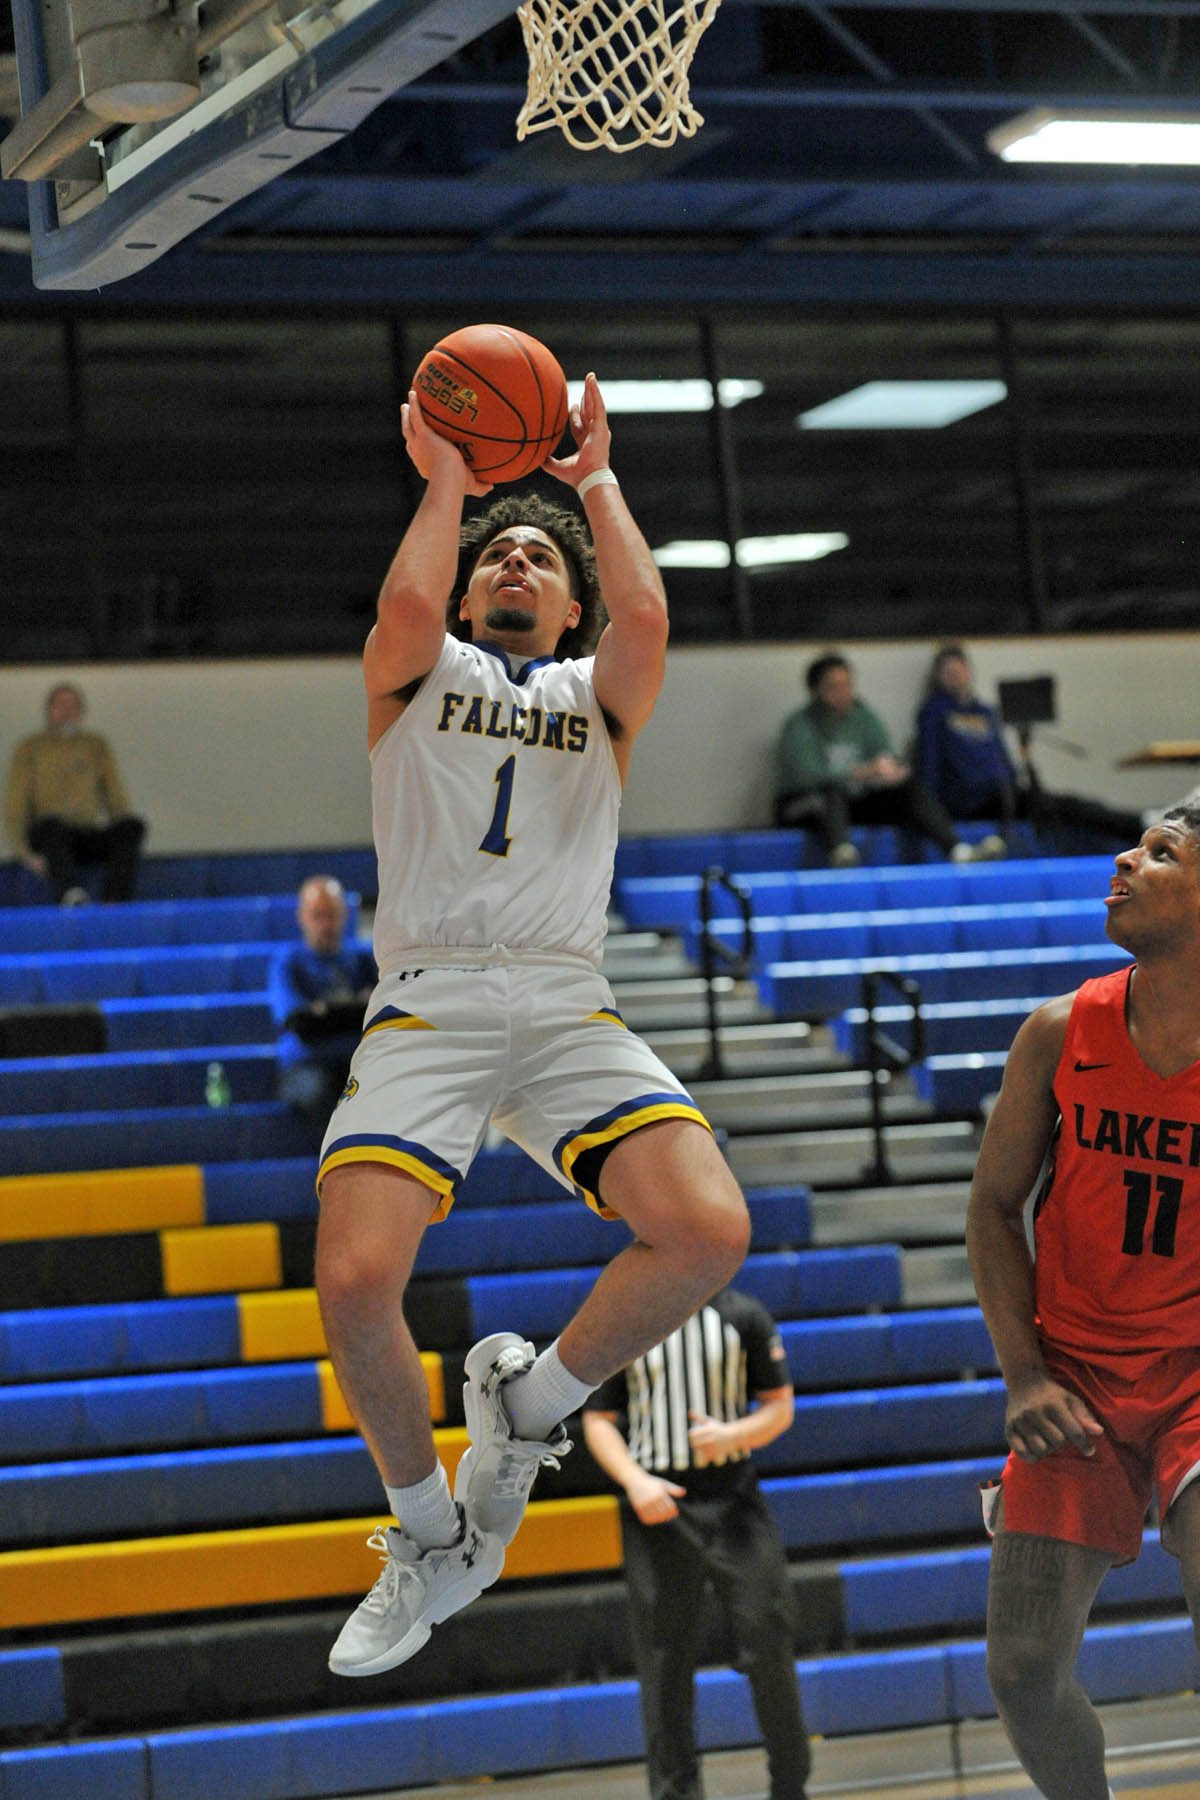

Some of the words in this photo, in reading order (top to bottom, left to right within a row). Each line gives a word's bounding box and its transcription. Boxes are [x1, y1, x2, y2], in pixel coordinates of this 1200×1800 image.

[437, 692, 589, 753] FALCONS
[478, 752, 516, 858] 1
[1121, 1169, 1184, 1258] 11
